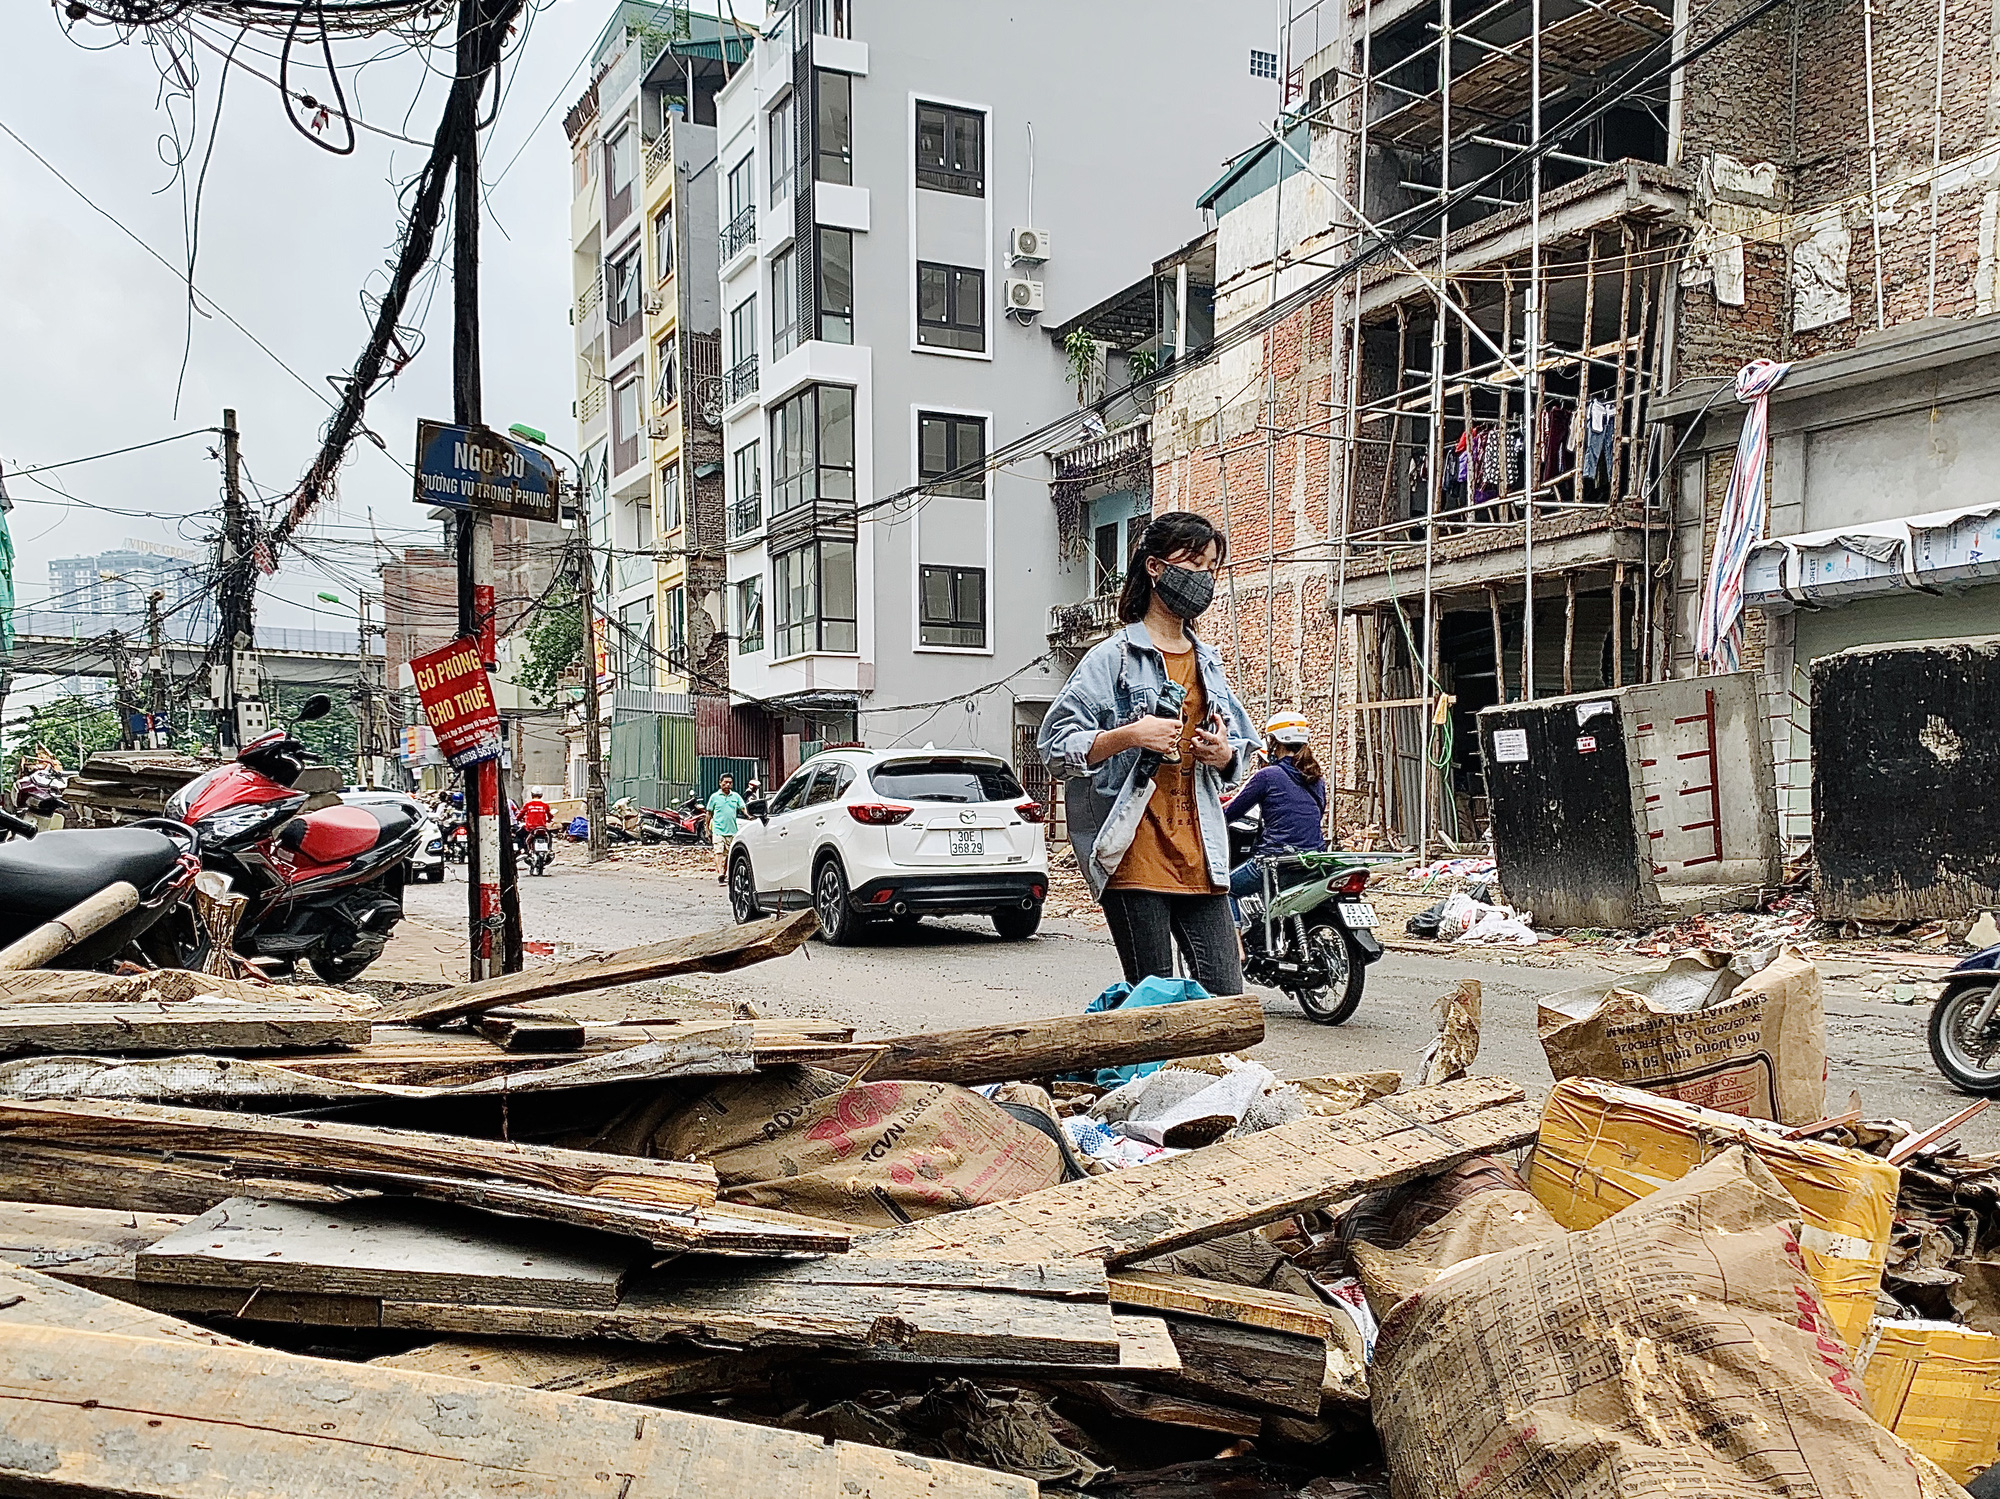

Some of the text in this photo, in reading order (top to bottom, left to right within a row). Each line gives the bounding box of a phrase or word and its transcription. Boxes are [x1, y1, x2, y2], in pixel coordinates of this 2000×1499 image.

[501, 452, 525, 478] 30
[416, 648, 482, 692] CÓ PHÒNG
[427, 682, 490, 727] CHO THUÊ
[957, 831, 976, 842] 30E
[952, 842, 983, 854] 368.29
[1642, 1055, 1659, 1069] 50
[1721, 1076, 1738, 1087] ISO
[860, 1122, 906, 1164] TCVN
